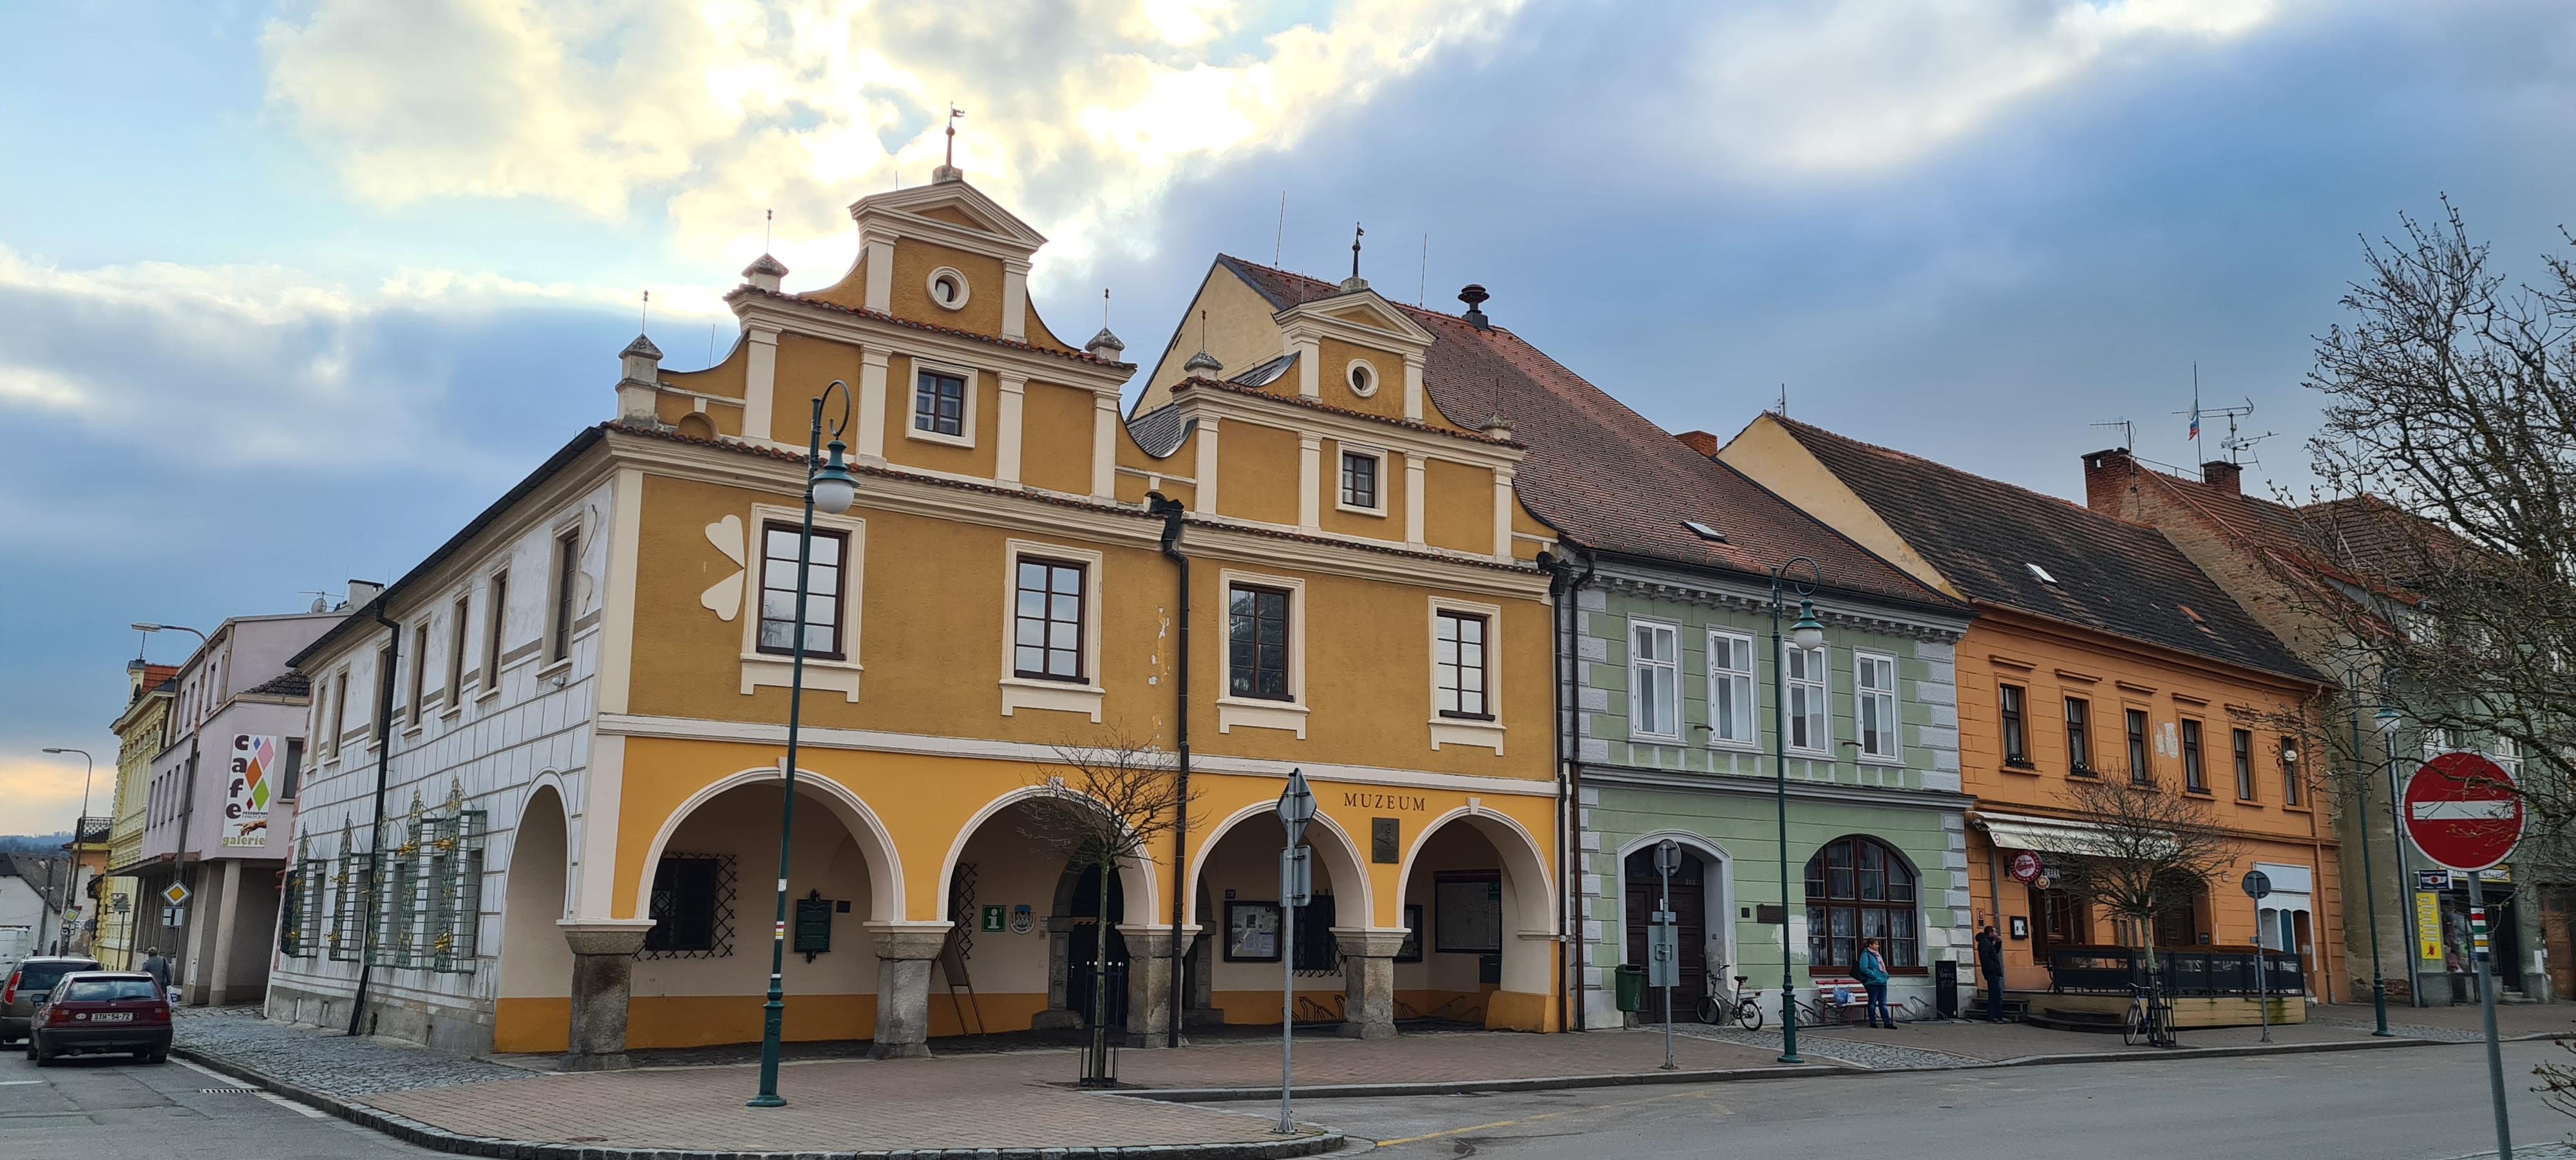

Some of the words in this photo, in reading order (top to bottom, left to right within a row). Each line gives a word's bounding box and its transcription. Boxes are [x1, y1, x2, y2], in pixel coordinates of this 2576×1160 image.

[225, 735, 249, 819] cafe
[1343, 792, 1425, 812] MUZEUM
[222, 835, 265, 846] galerie
